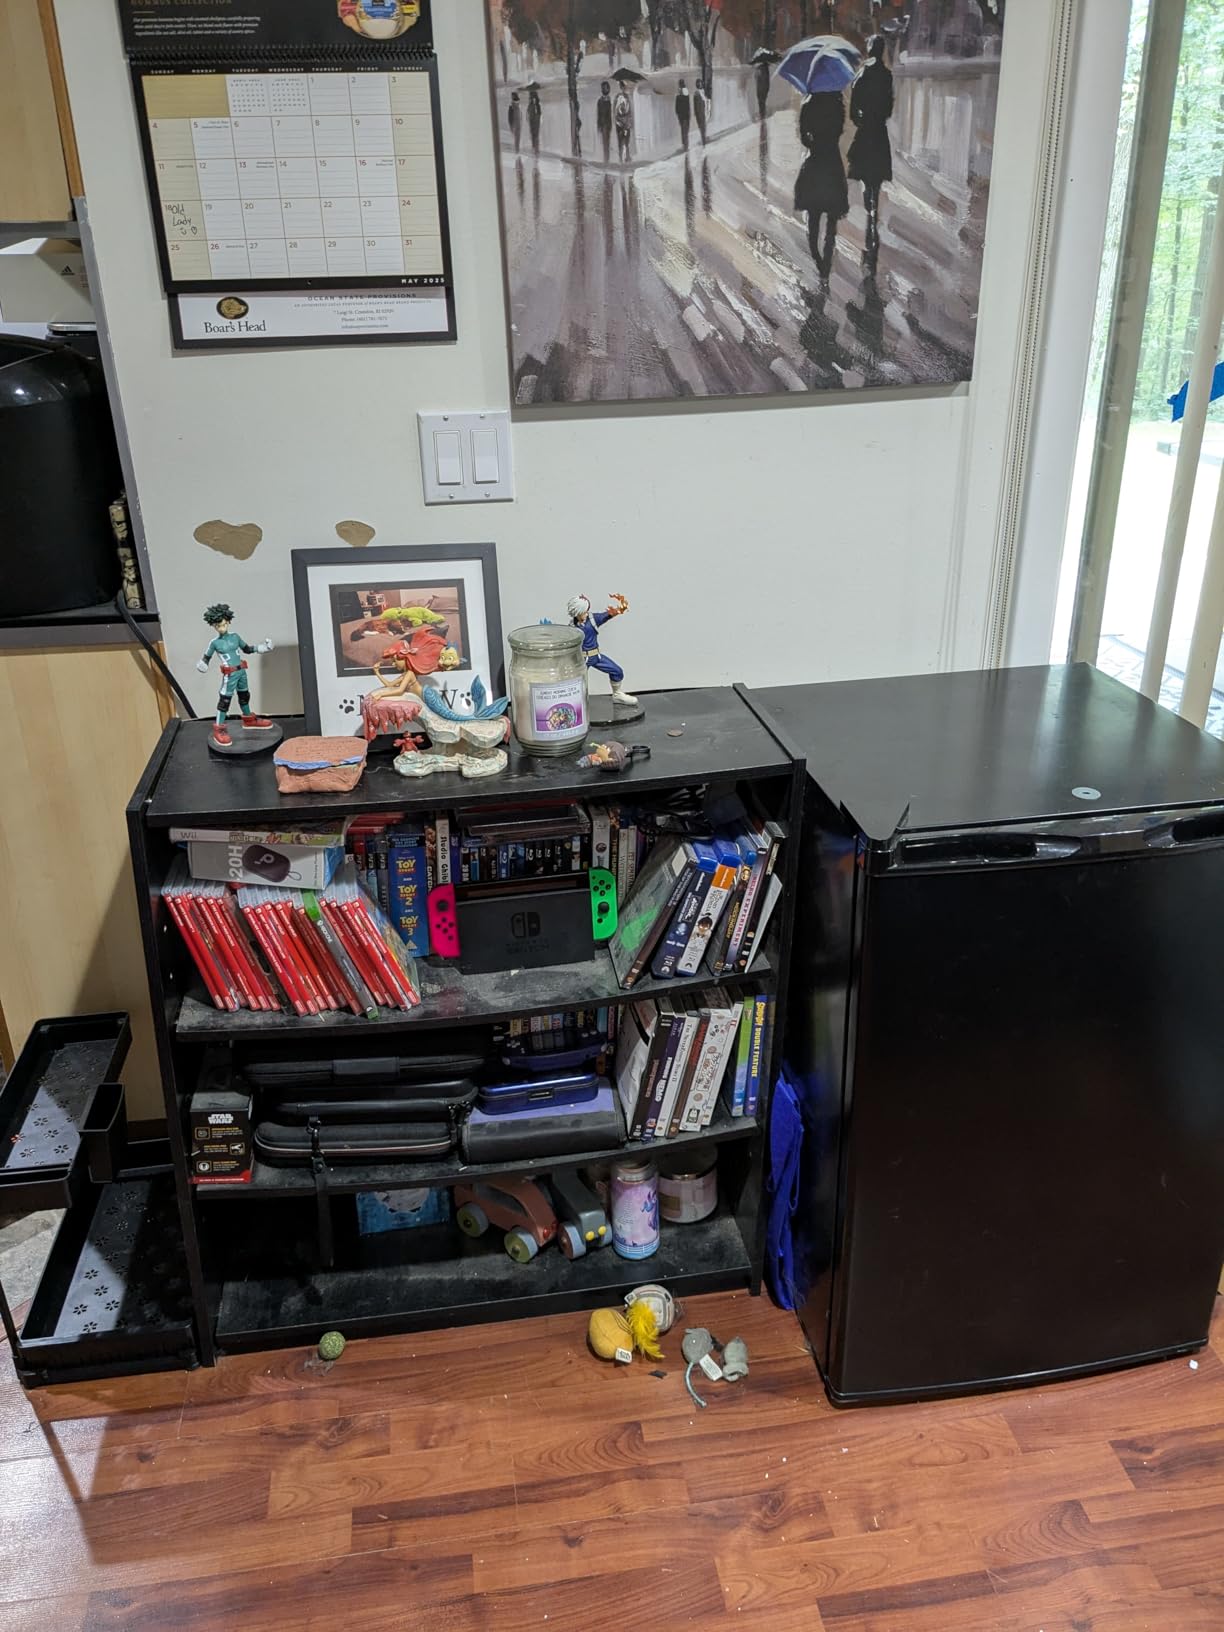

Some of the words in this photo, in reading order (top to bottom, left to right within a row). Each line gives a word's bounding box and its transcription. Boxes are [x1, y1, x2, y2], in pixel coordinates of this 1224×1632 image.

[193, 121, 199, 129] 5
[327, 240, 337, 248] 29
[203, 321, 236, 334] Boar's
[237, 320, 267, 332] Head
[180, 831, 197, 839] Wii
[440, 836, 448, 860] Studio
[396, 859, 416, 869] TOY
[398, 884, 417, 894] TOY
[405, 897, 413, 906] 2
[400, 916, 419, 925] TOY
[733, 897, 752, 948] EXPERIMENT
[408, 928, 414, 936] 3
[753, 1027, 762, 1050] DOUBLE
[751, 1050, 760, 1077] FEATURE
